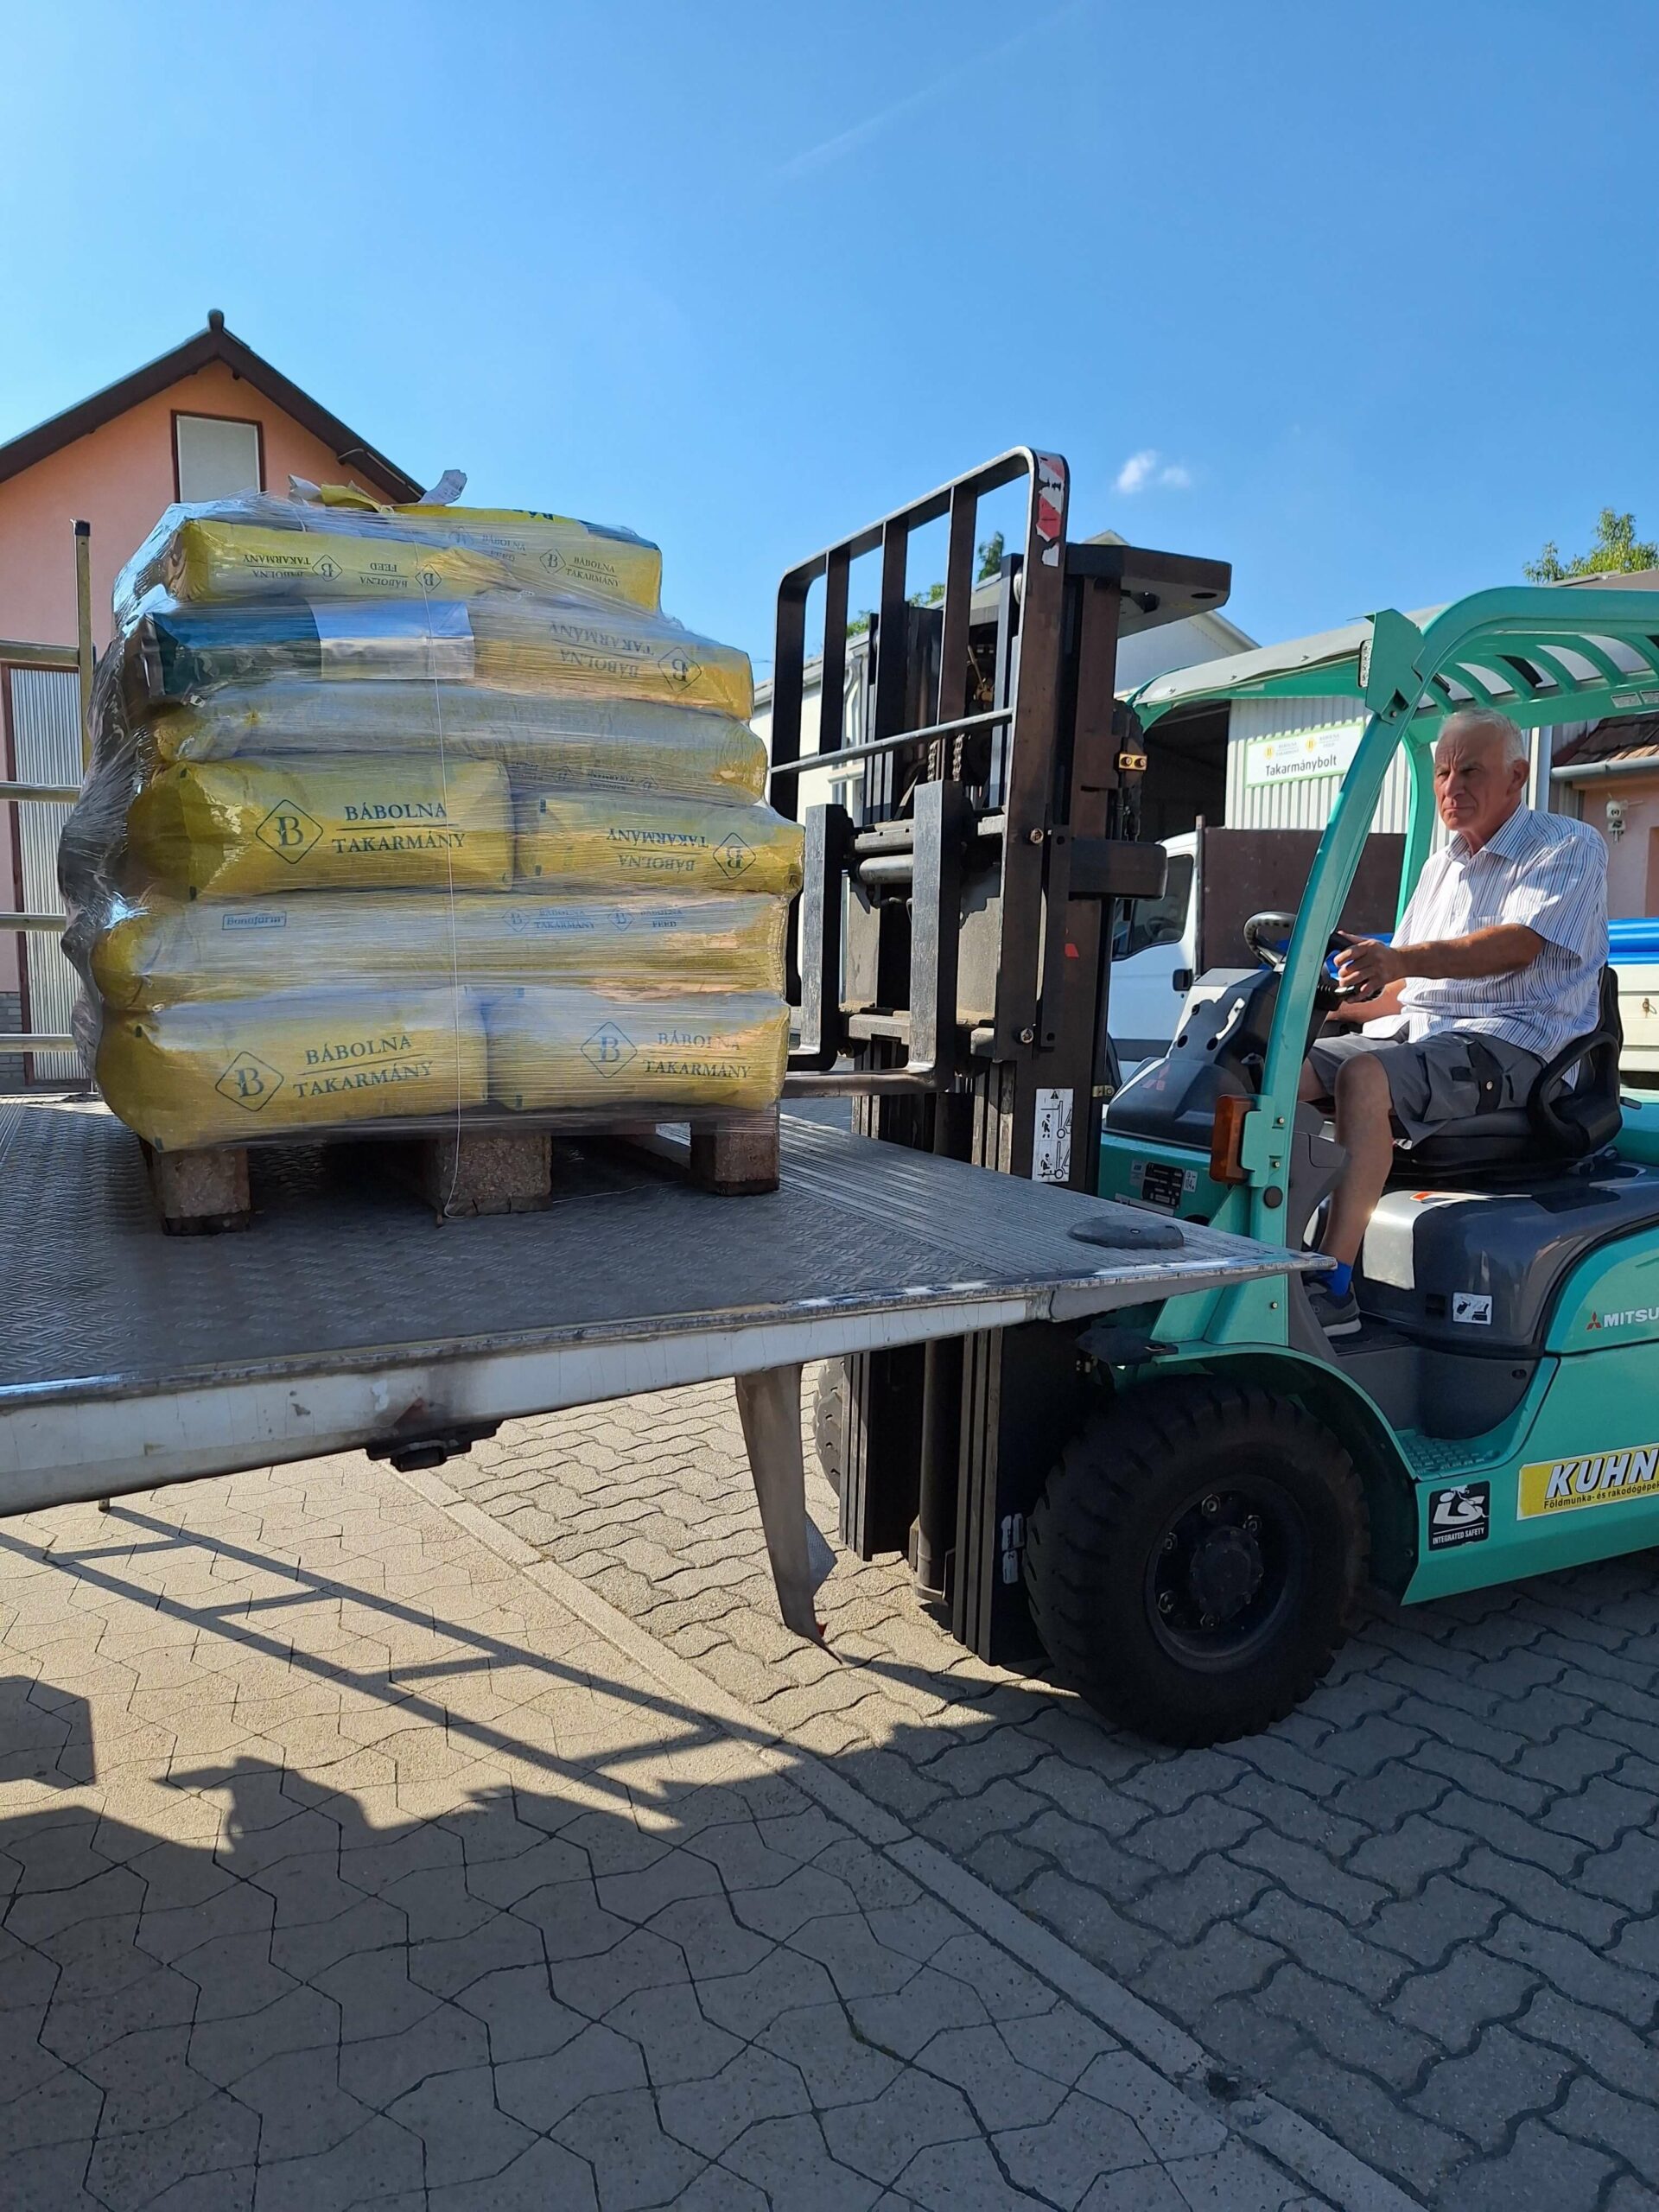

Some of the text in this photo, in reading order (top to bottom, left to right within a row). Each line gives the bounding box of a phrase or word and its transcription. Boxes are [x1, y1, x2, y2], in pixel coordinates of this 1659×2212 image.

[370, 563, 397, 572] FEED
[574, 556, 615, 574] BÁBOLNA
[565, 568, 620, 587] TAKARMÁNY
[549, 621, 654, 656] TAKARMÁNY
[560, 648, 639, 678] BÁBOLNA
[1266, 754, 1338, 777] Takarmánybolt
[344, 802, 447, 821] BÁBOLNA
[332, 830, 466, 854] TAKARMÁNY
[606, 828, 709, 849] TAKARMÁNY
[617, 854, 695, 873] BÁBOLNA
[305, 1035, 411, 1065] BÁBOLNA
[293, 1060, 434, 1097] TAKARMÁNY
[643, 1059, 751, 1078] TAKARMÁNY
[1604, 1306, 1659, 1328] MITSU
[1545, 1448, 1659, 1500] KUHN
[1544, 1494, 1595, 1510] Földmunka-
[1433, 1528, 1485, 1545] INTEGRATED SAFETY
